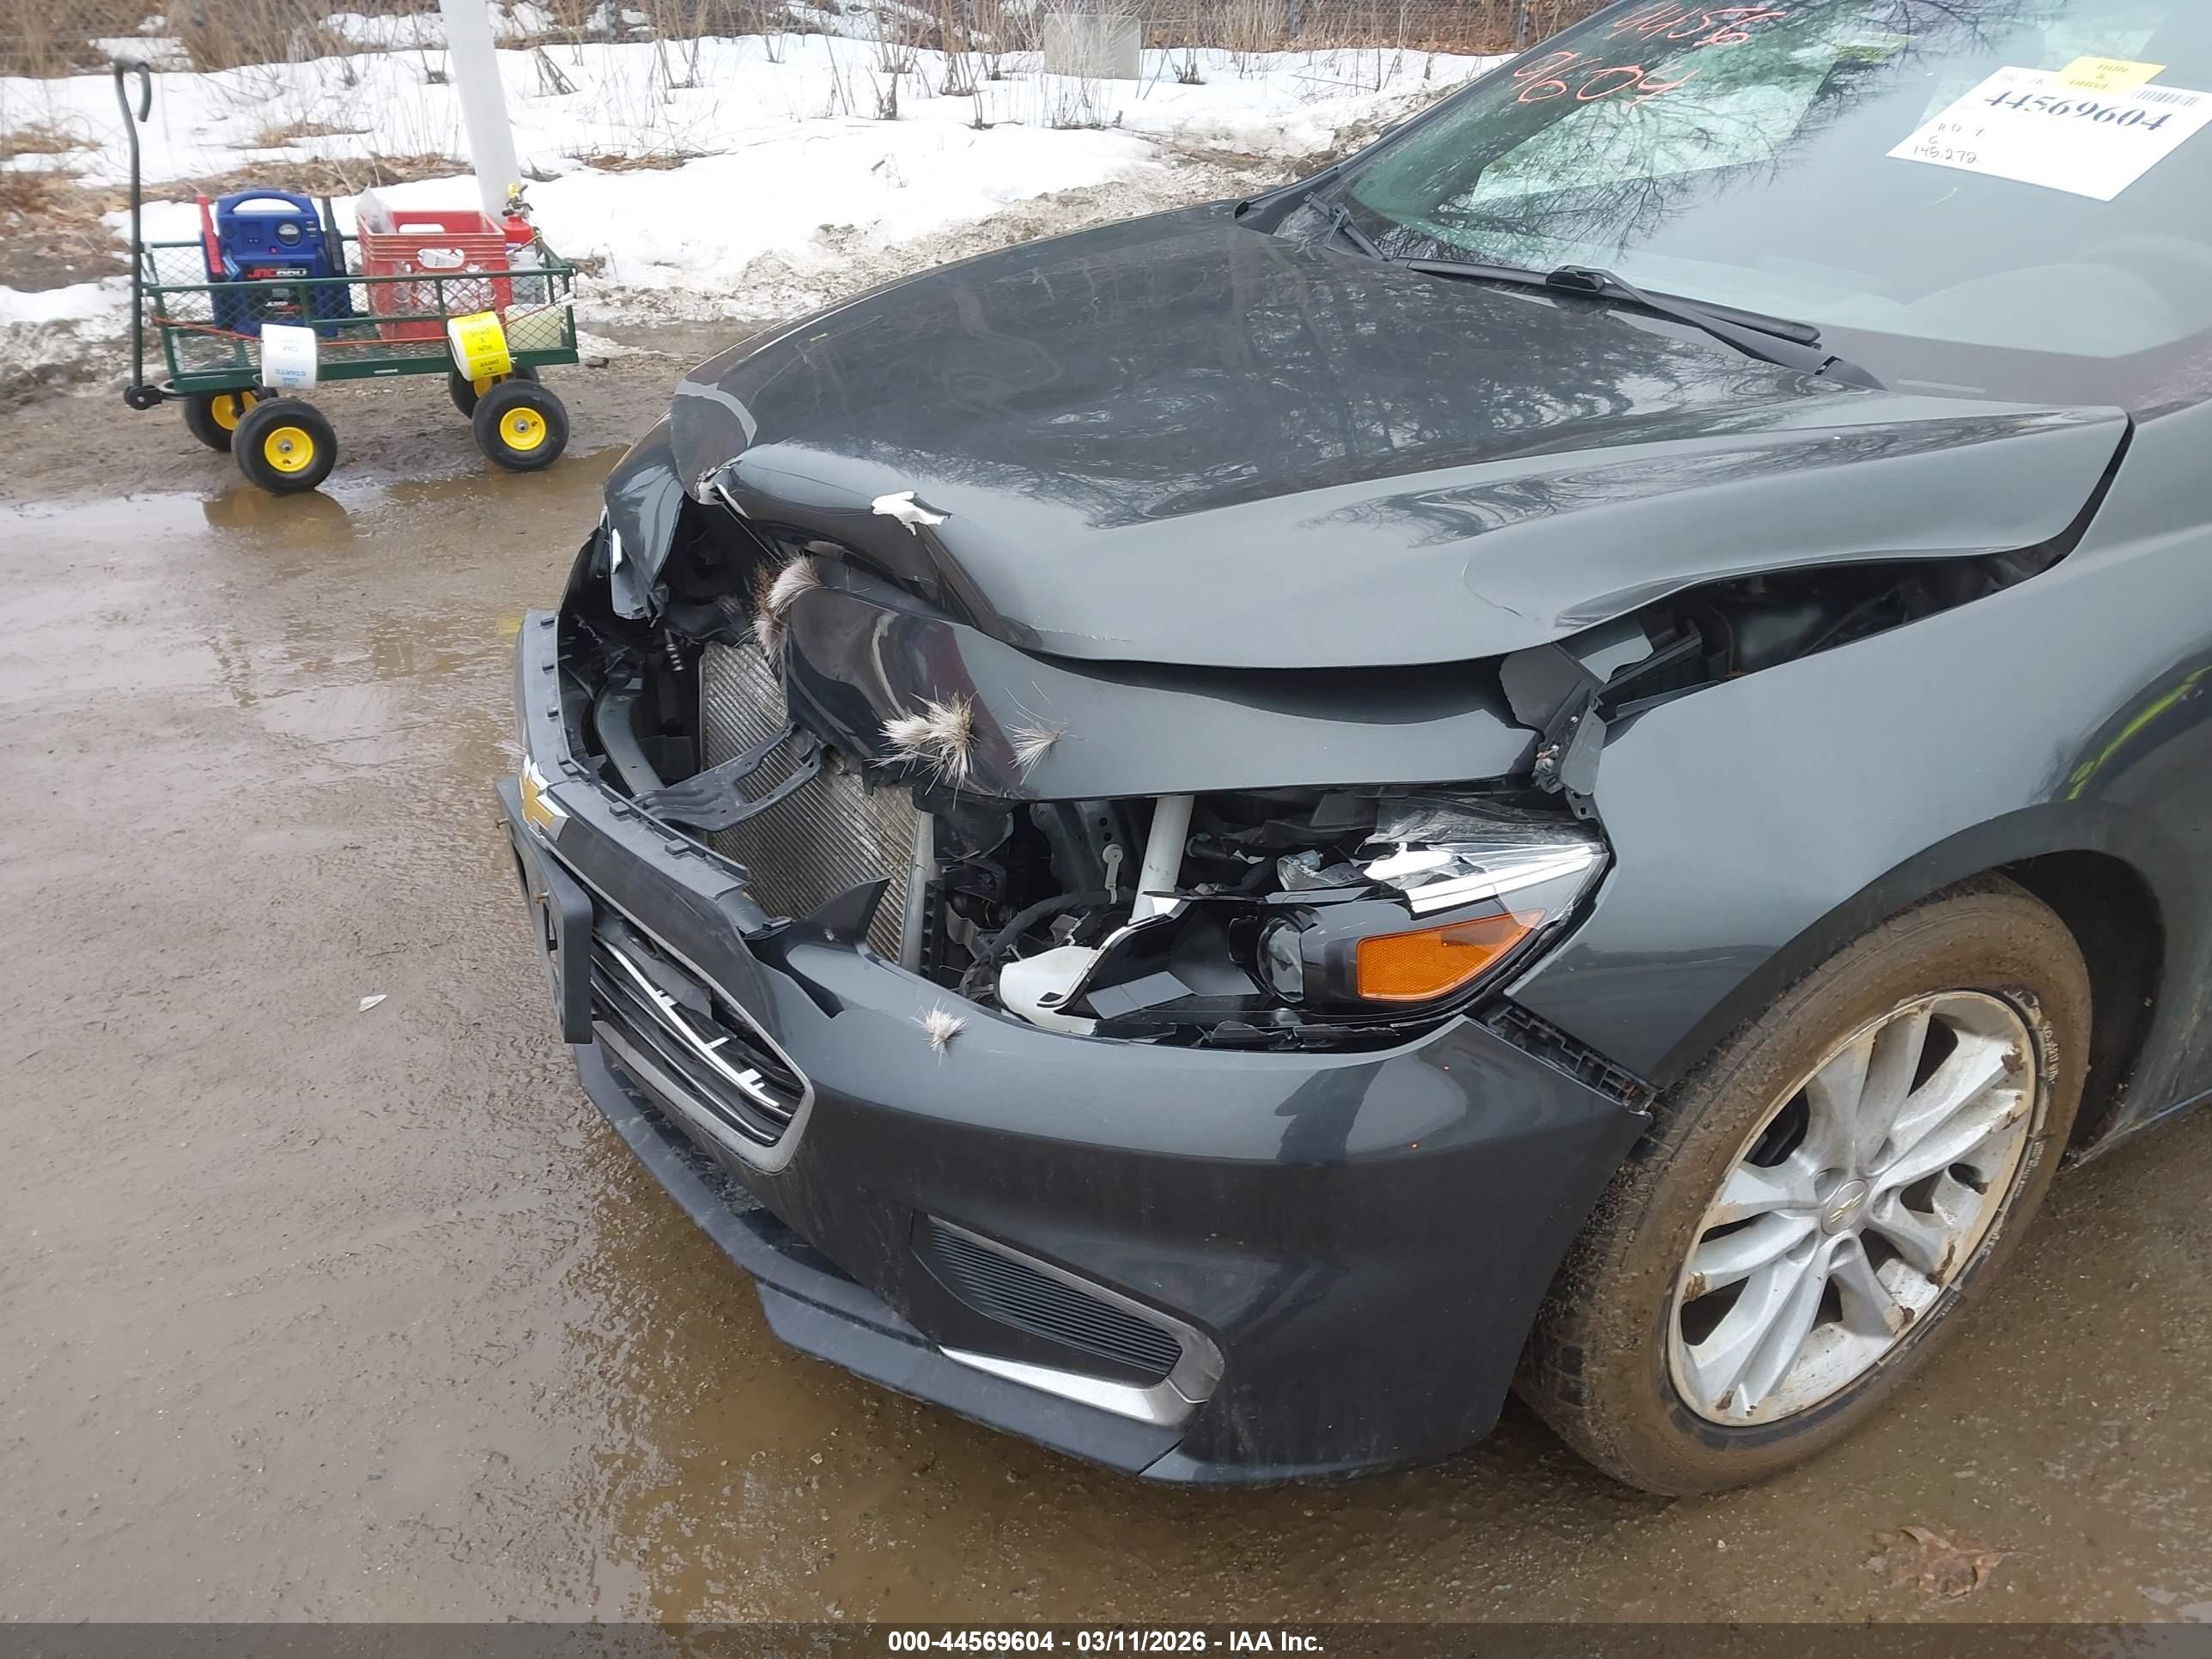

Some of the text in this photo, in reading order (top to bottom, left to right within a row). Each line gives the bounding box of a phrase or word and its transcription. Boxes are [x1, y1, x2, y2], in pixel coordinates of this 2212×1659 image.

[1607, 3, 1787, 46] 4456
[1510, 52, 1702, 109] 9604
[2069, 79, 2113, 90] DRIVE
[1984, 90, 2173, 131] 44569604
